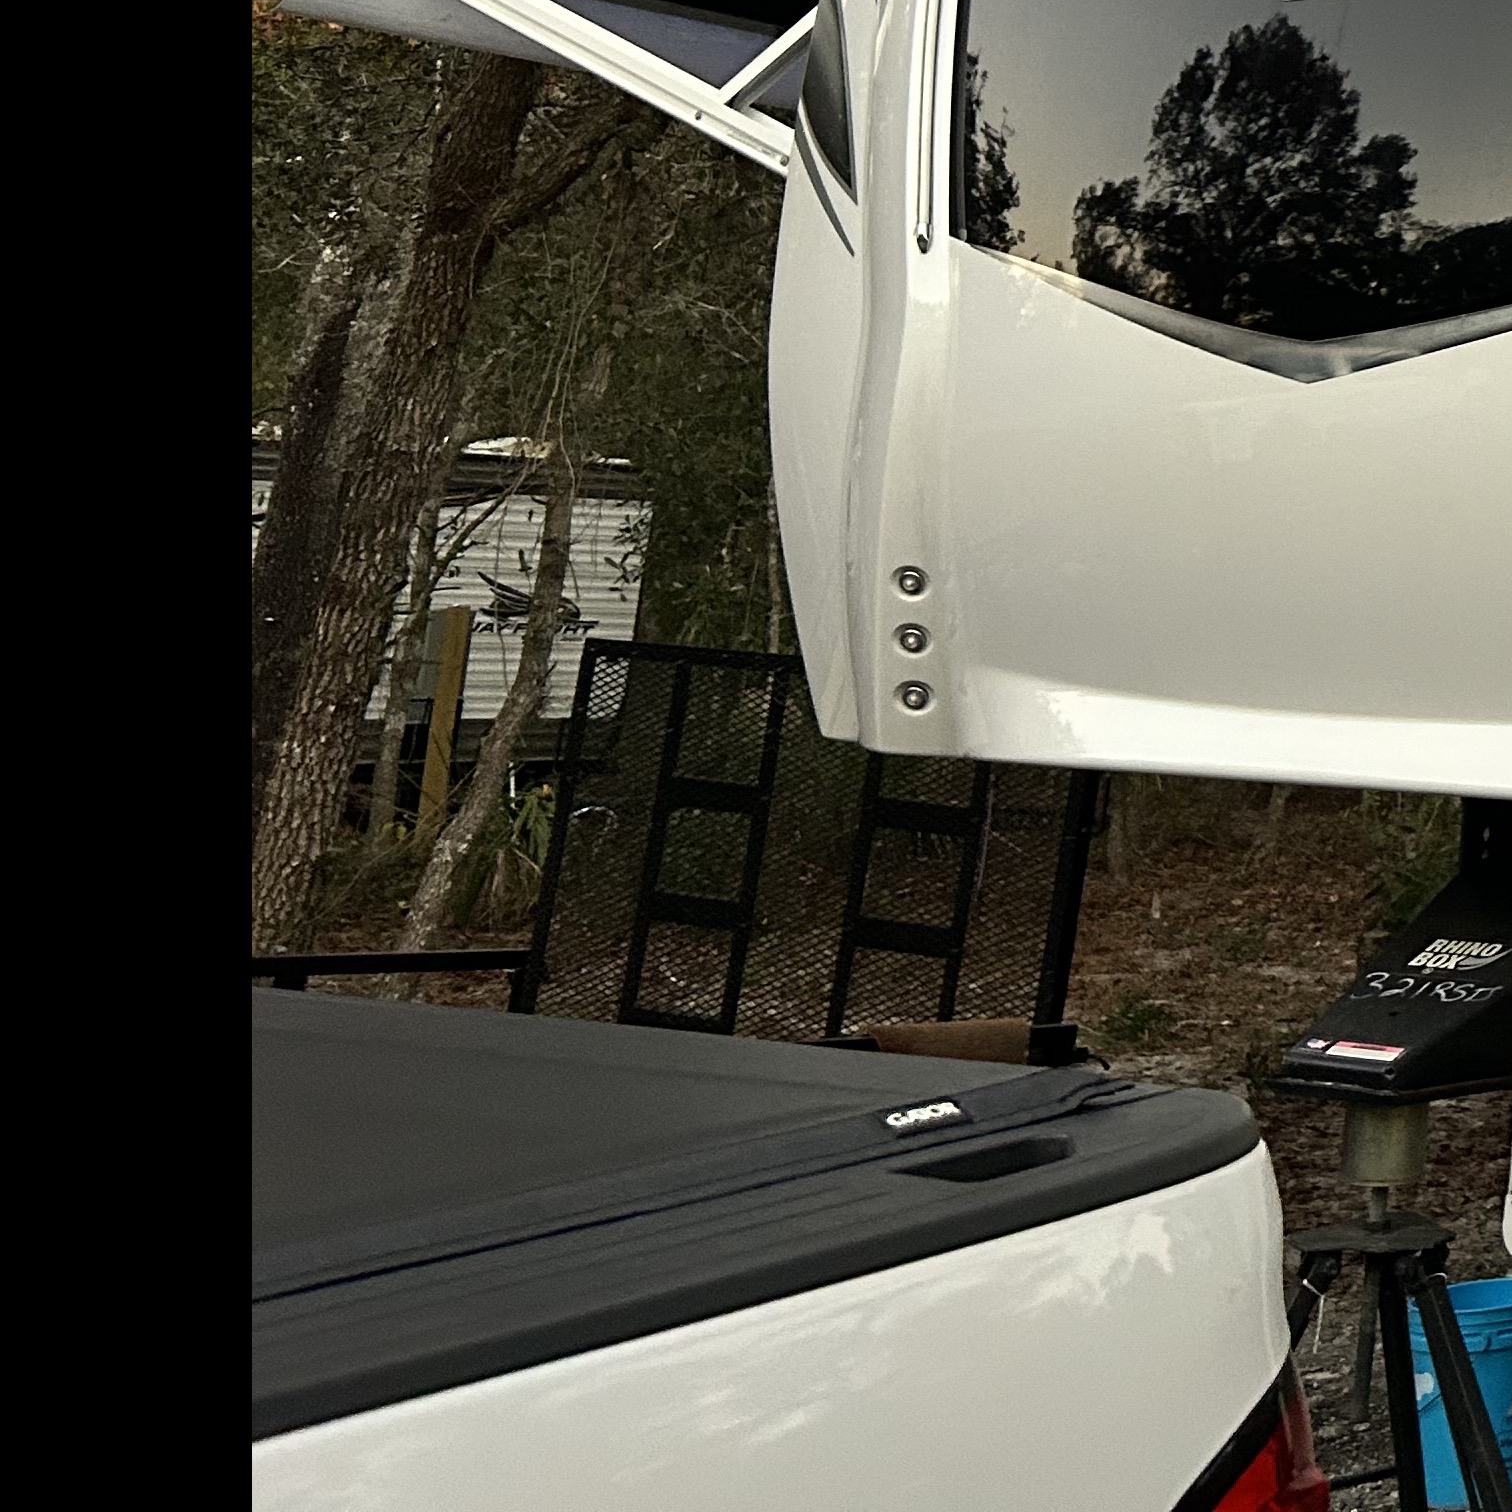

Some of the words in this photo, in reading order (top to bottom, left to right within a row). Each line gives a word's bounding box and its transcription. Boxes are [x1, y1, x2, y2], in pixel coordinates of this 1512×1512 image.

[513, 622, 596, 635] FHT
[1425, 938, 1503, 958] RHINO
[1407, 951, 1467, 971] BOX
